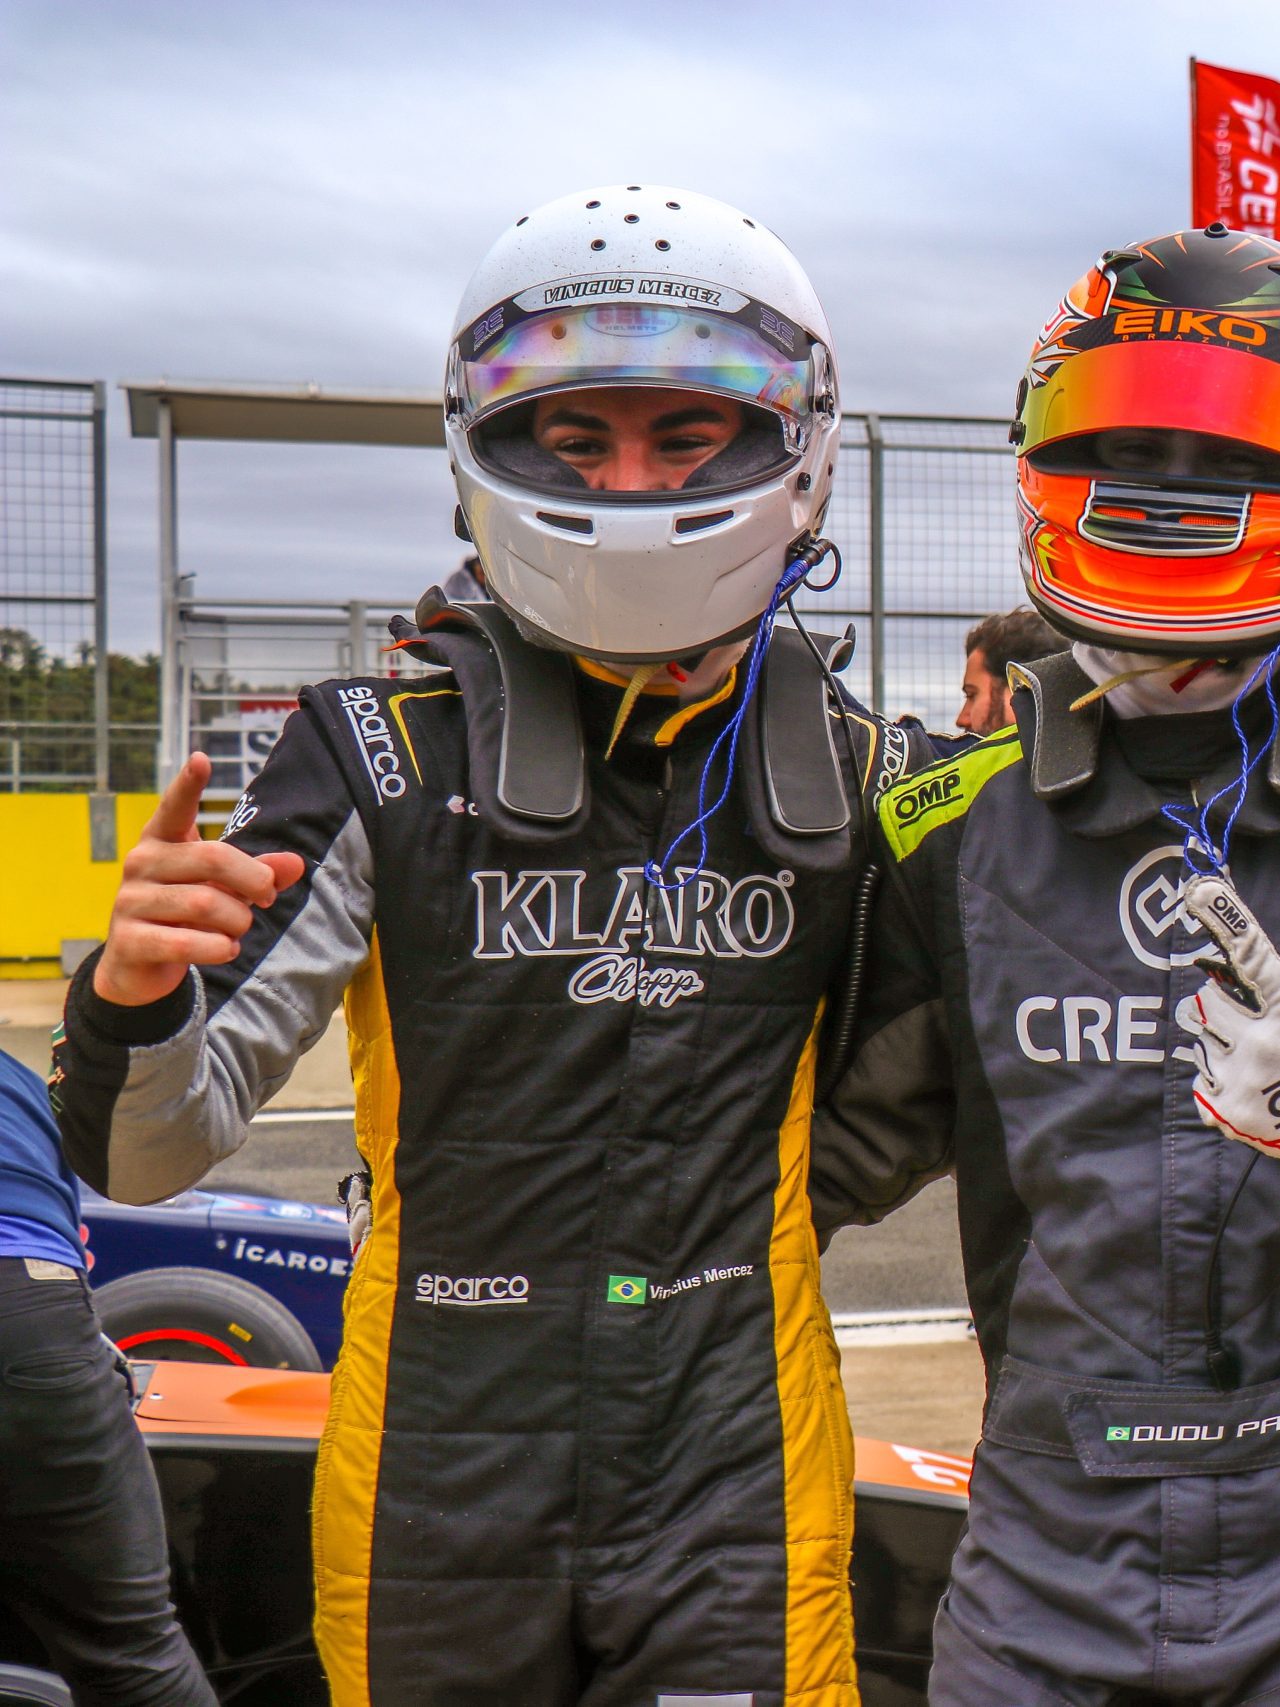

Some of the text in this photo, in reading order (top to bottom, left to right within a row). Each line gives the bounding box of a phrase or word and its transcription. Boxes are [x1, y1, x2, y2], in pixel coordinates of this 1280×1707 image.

[545, 279, 721, 306] VINICIUS MERCEZ
[1113, 310, 1268, 347] EIKO
[340, 686, 407, 799] sparco
[895, 774, 961, 819] OMP
[1213, 895, 1248, 930] OMP
[568, 953, 704, 1008] Chopp
[416, 1274, 530, 1305] sparco
[650, 1265, 754, 1300] Vincius Mercez
[1132, 1425, 1225, 1441] DUDU
